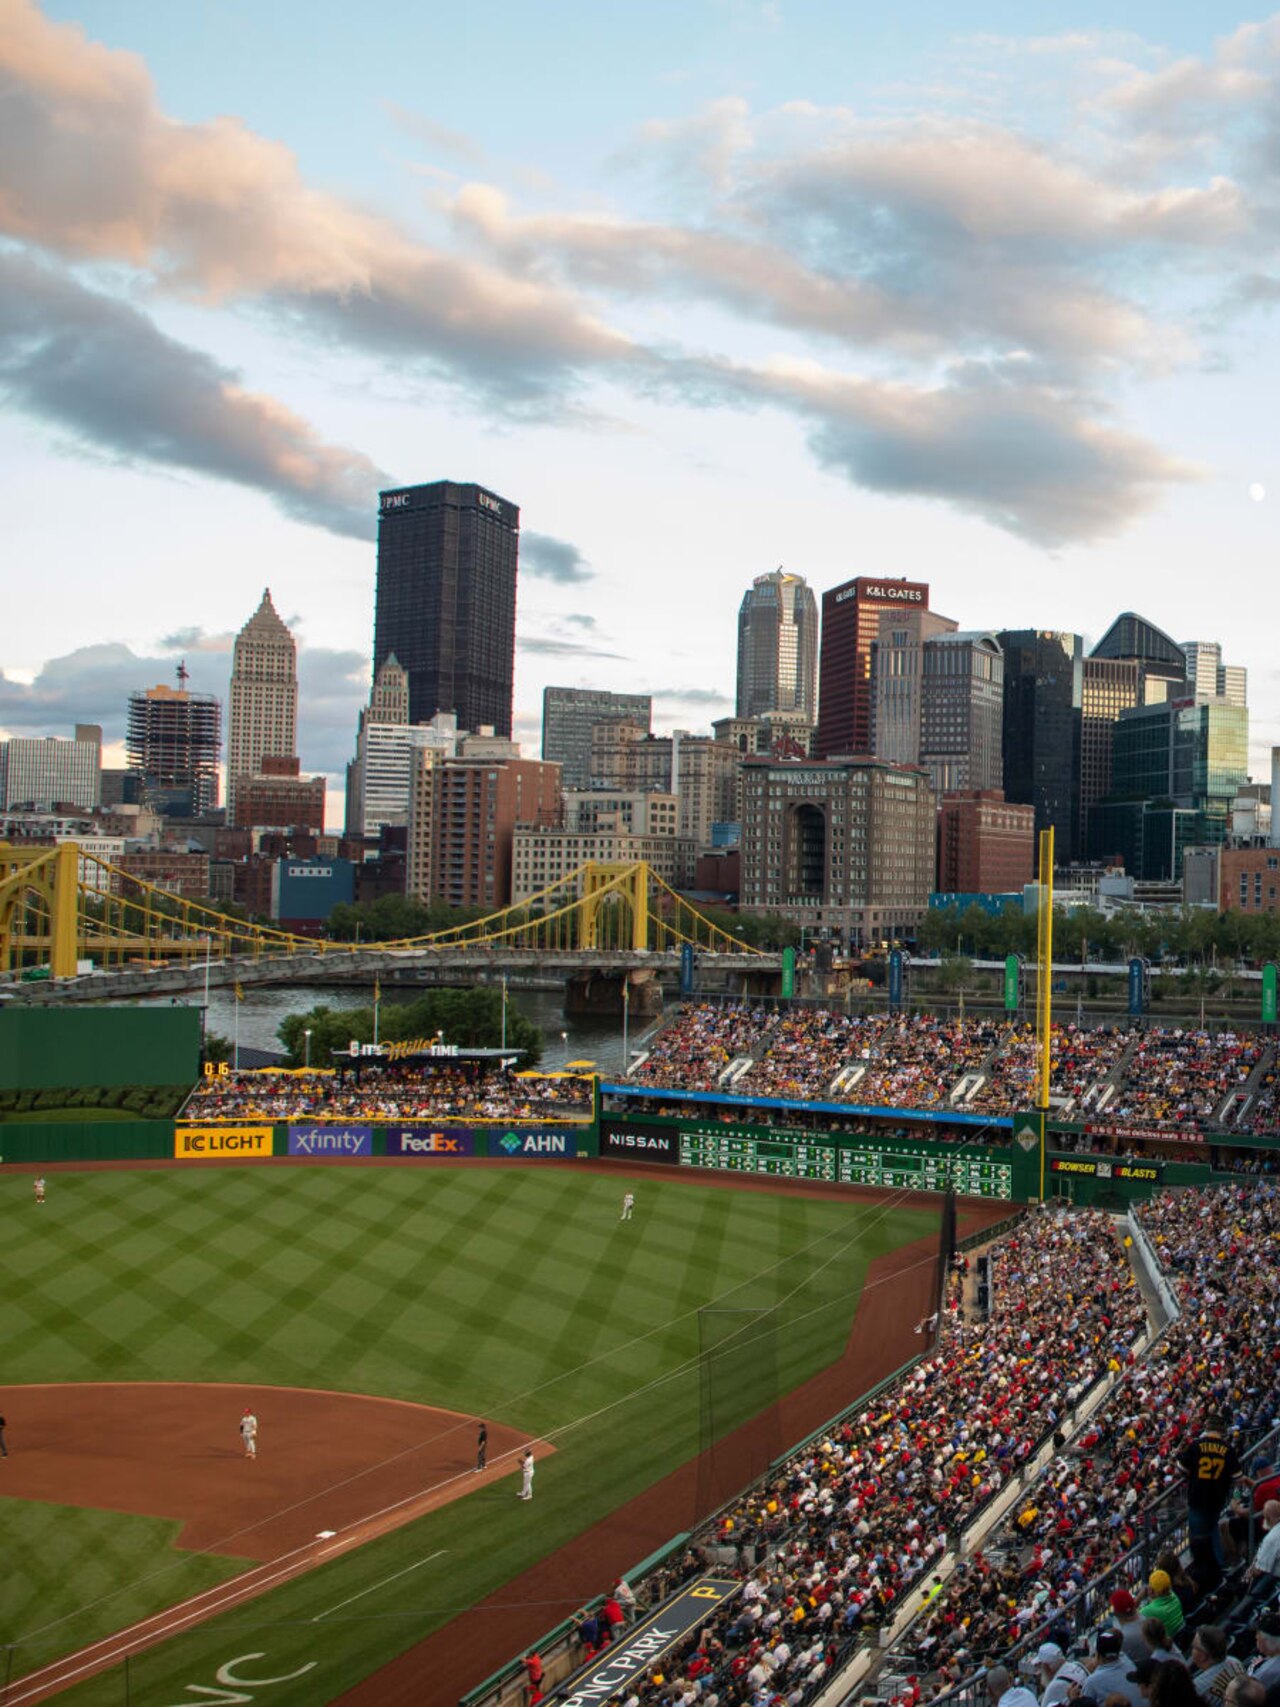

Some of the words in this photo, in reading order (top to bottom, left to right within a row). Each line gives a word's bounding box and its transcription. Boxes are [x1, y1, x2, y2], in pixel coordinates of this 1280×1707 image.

[866, 586, 886, 598] K&L
[887, 588, 922, 601] GATES
[379, 1036, 439, 1062] Miller
[430, 1045, 459, 1057] TIME
[184, 1136, 205, 1151] IC
[209, 1135, 265, 1150] LIGHT
[296, 1130, 365, 1154] xfinity
[401, 1133, 458, 1152] FedEx
[523, 1135, 566, 1152] AHN
[609, 1133, 670, 1150] NISSAN
[1058, 1161, 1096, 1173] BOWSER
[1121, 1167, 1157, 1179] BLASTS
[1198, 1456, 1225, 1480] 27
[608, 1627, 679, 1671] PARK
